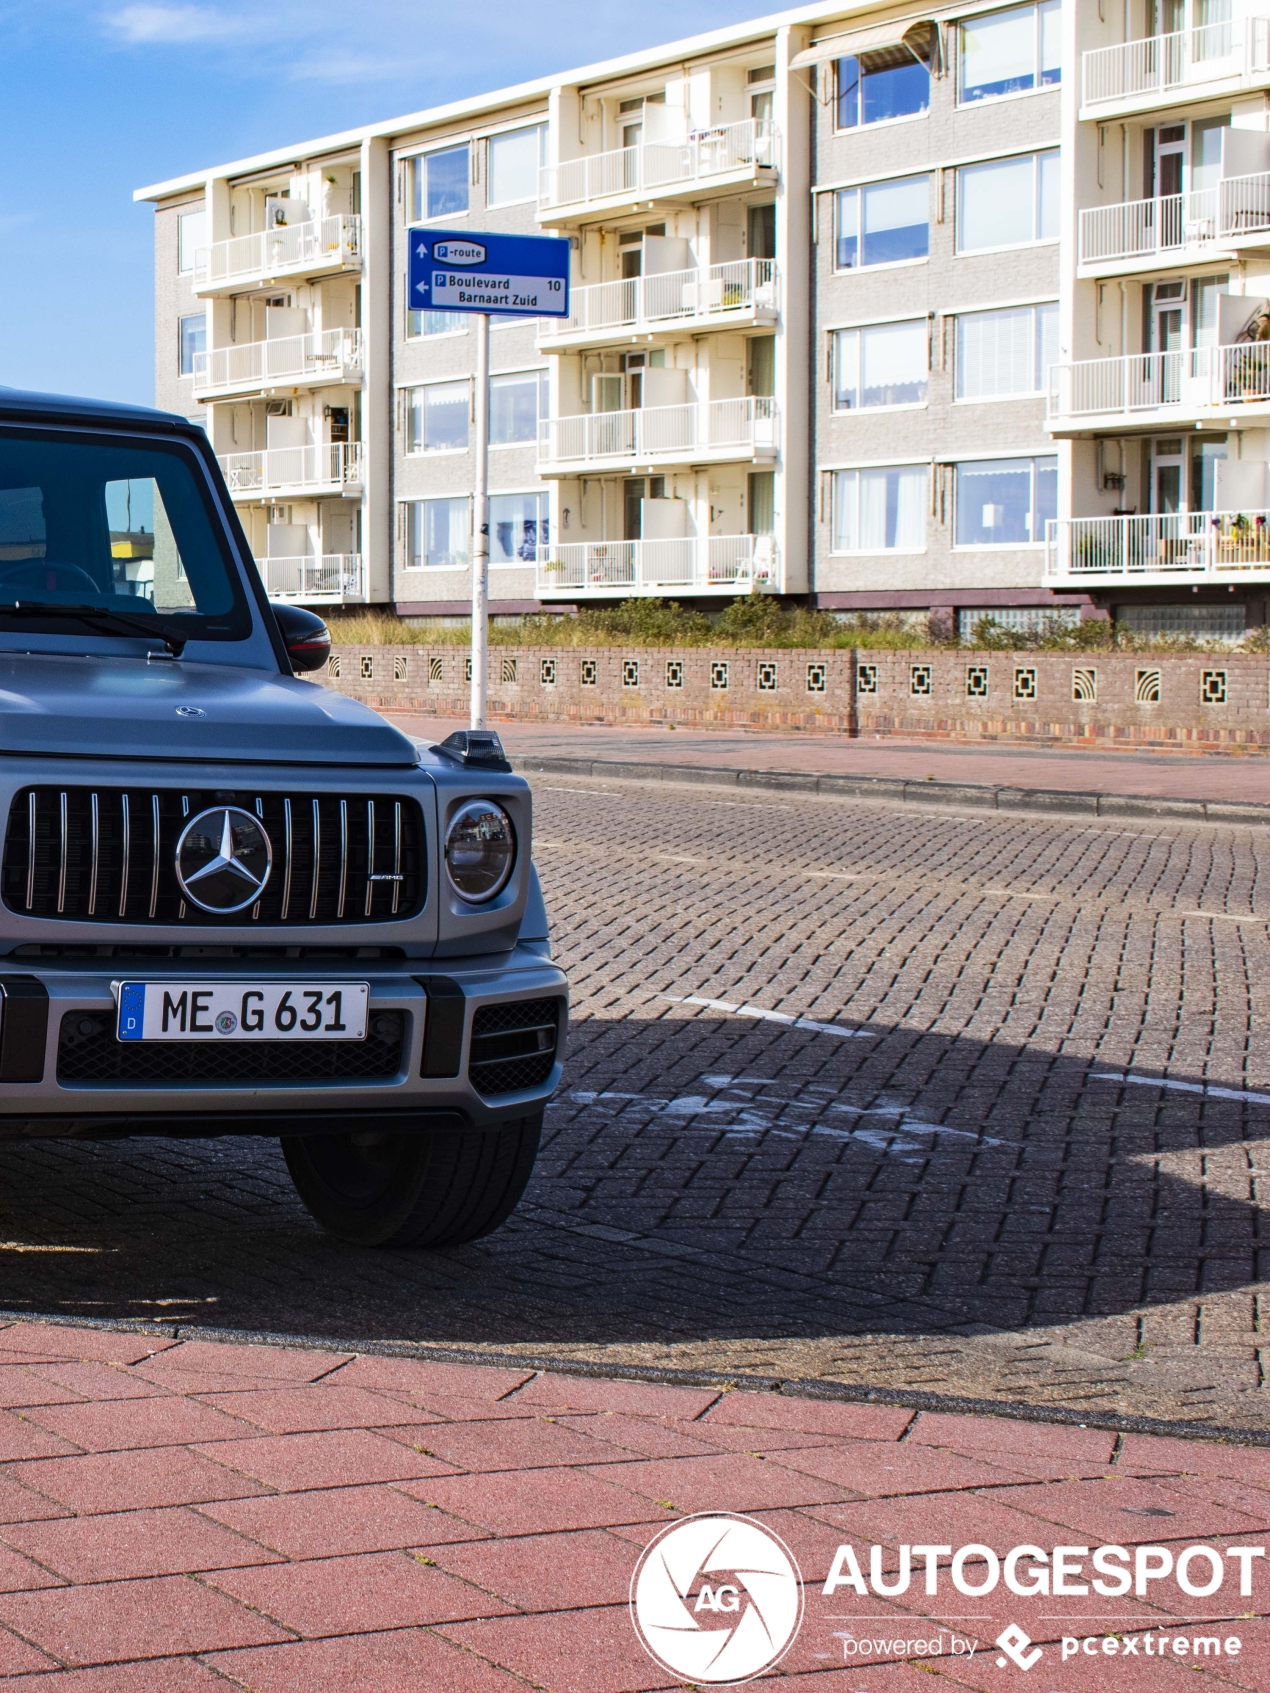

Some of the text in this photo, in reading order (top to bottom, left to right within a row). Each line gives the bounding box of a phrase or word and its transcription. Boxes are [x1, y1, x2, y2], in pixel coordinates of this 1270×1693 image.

[448, 275, 510, 289] Boulevard
[547, 280, 561, 291] 10
[459, 291, 537, 306] Barnaart Zuid
[127, 990, 346, 1033] D ME G 631
